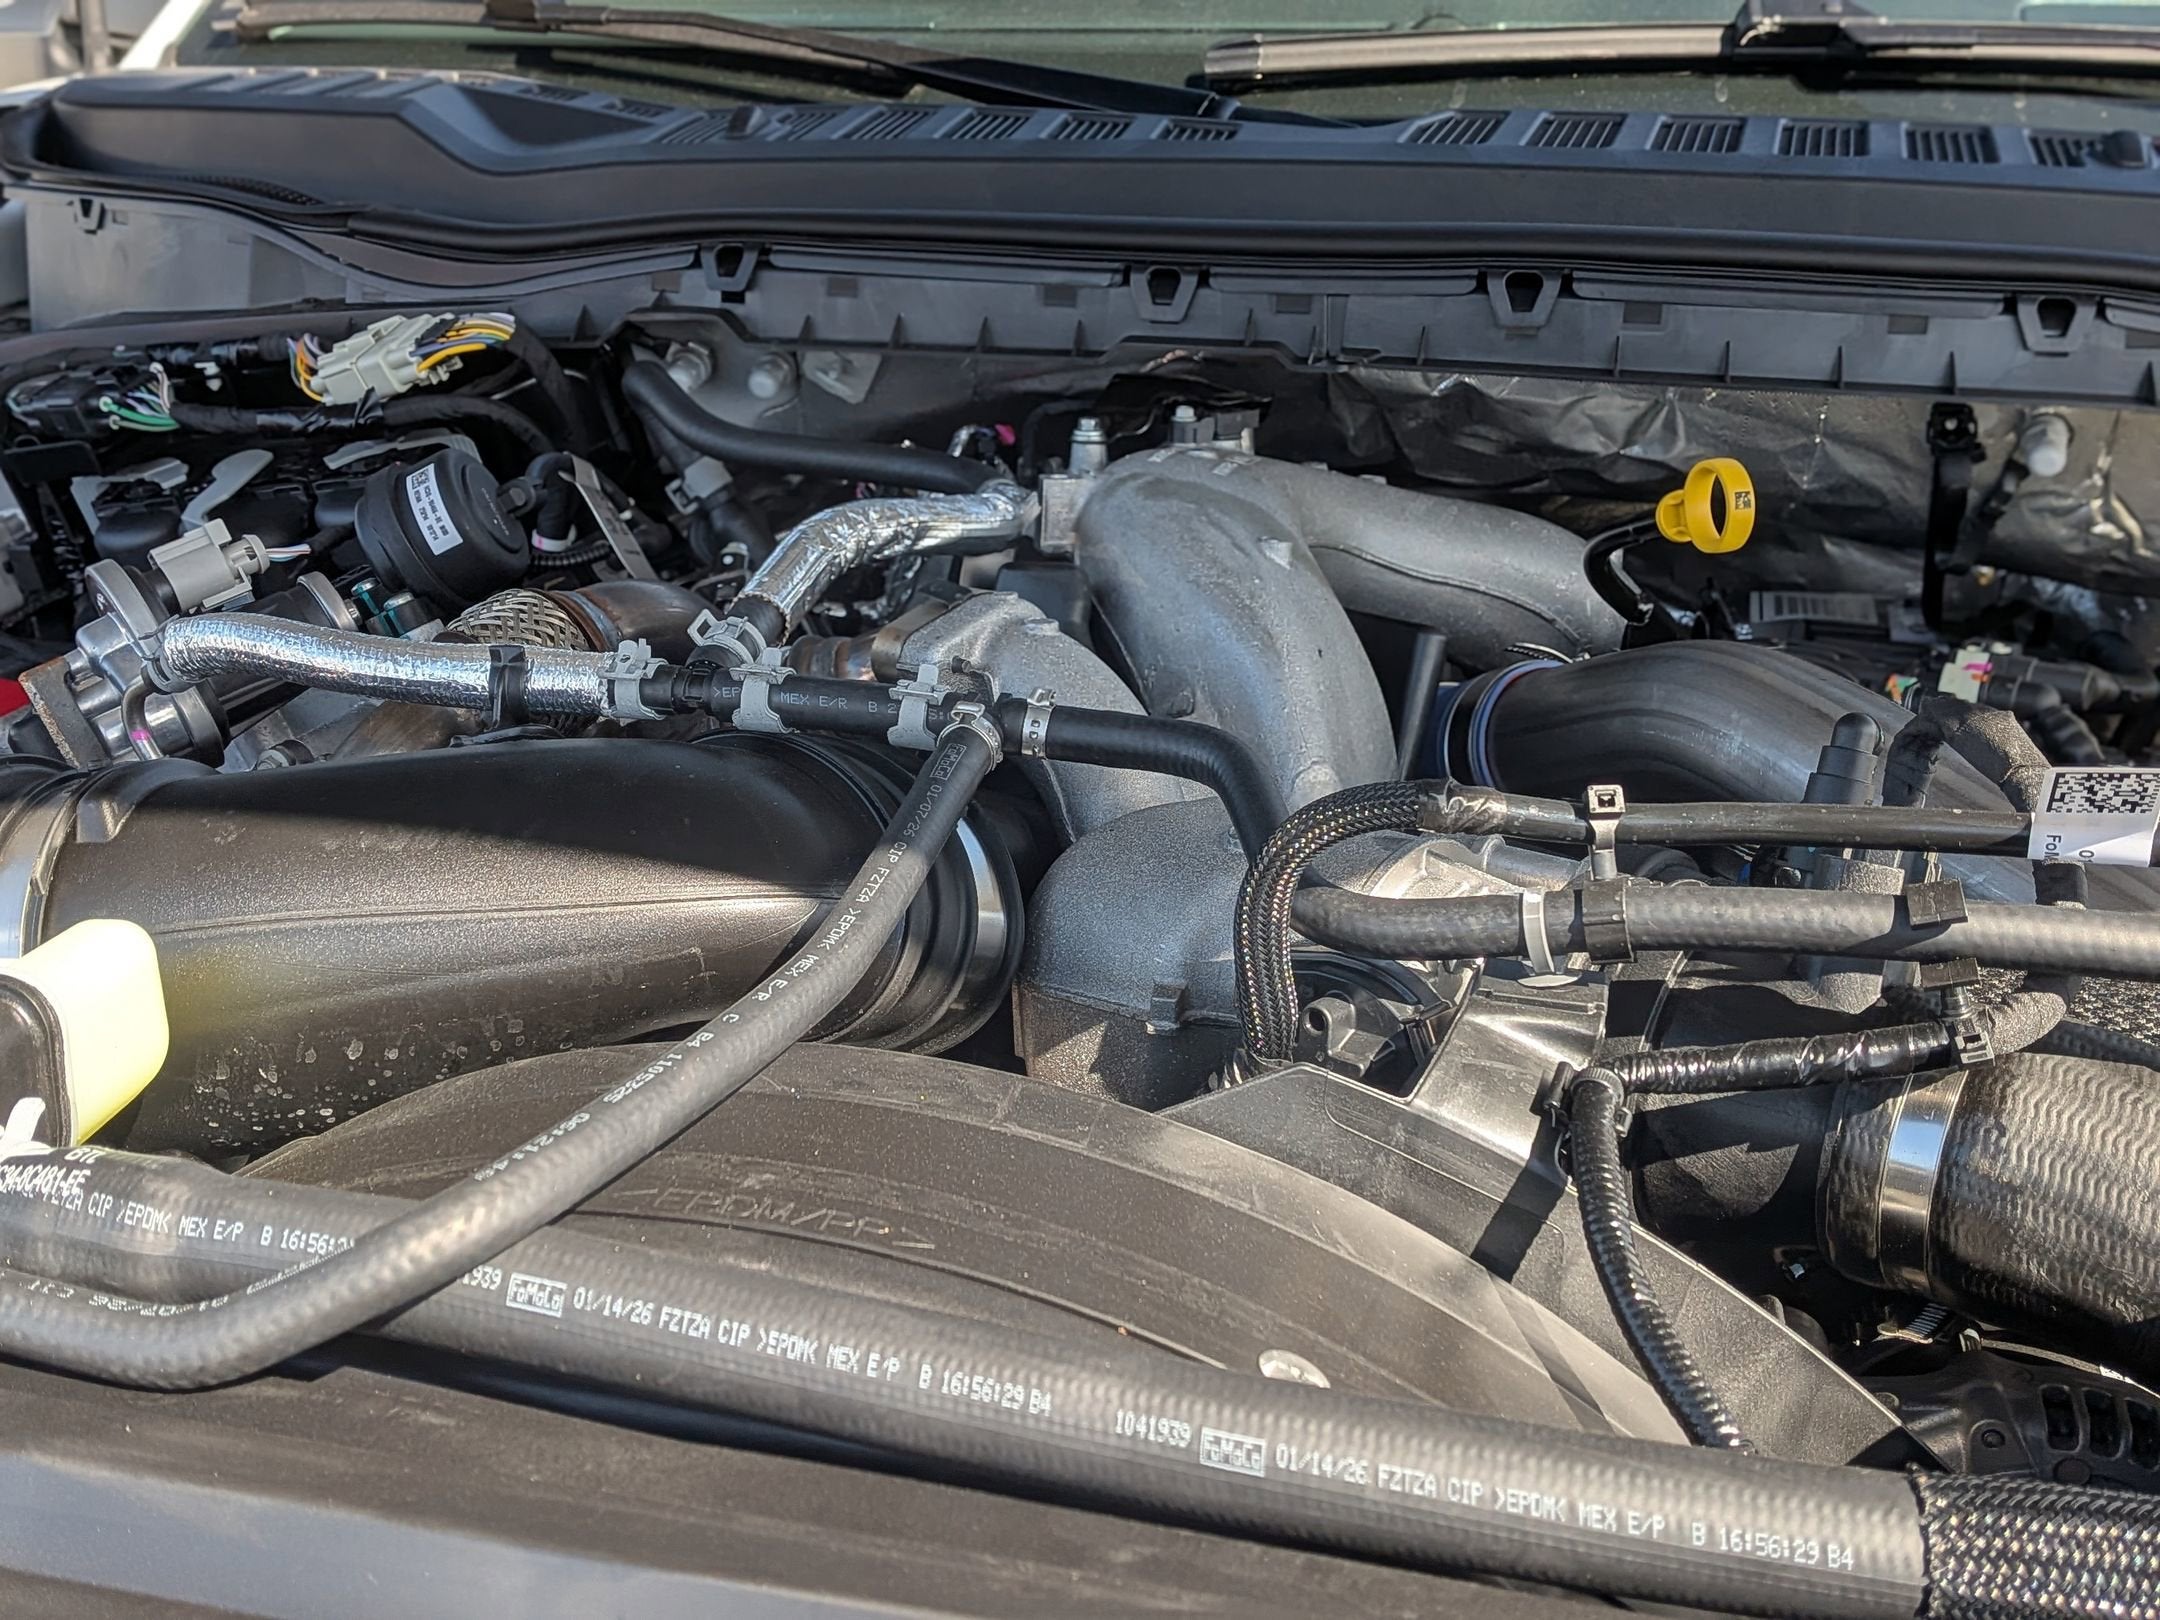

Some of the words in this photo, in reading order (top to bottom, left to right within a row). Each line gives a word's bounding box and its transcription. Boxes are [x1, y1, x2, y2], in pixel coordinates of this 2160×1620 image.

[713, 687, 741, 698] >EP
[780, 691, 810, 706] MEX
[868, 702, 878, 713] B
[931, 743, 967, 780] FoMoCo
[904, 784, 942, 837] 01/07/26
[887, 841, 907, 864] CIP
[785, 954, 819, 977] MEX
[88, 1192, 113, 1218] CIP
[116, 1200, 172, 1234] >EPDM<
[178, 1215, 208, 1238] MEX
[213, 1219, 244, 1242] E/P
[260, 1225, 273, 1246] B
[507, 1275, 566, 1315] FoMoCo
[573, 1286, 655, 1325] 01/14/26
[658, 1306, 711, 1339] FZTZA
[718, 1319, 750, 1348] CIP
[756, 1327, 819, 1365] >EPDM<
[826, 1344, 861, 1375] MEX
[866, 1353, 900, 1381] E/P
[918, 1363, 932, 1390] B
[941, 1369, 1025, 1411] 16:56:29
[1029, 1388, 1051, 1416] B4
[1114, 1408, 1193, 1448] 1041939
[1201, 1430, 1264, 1475] FoMoCo
[1275, 1442, 1369, 1485] 01/14/26
[1378, 1463, 1437, 1498] FZTZA
[1447, 1477, 1483, 1506] CIP
[1494, 1487, 1567, 1523] >EPDM<
[1578, 1504, 1616, 1533] MEX
[1627, 1511, 1665, 1540] E/P
[1692, 1523, 1706, 1547] B
[1719, 1528, 1819, 1565] 16:56:29
[1827, 1544, 1854, 1572] B4
